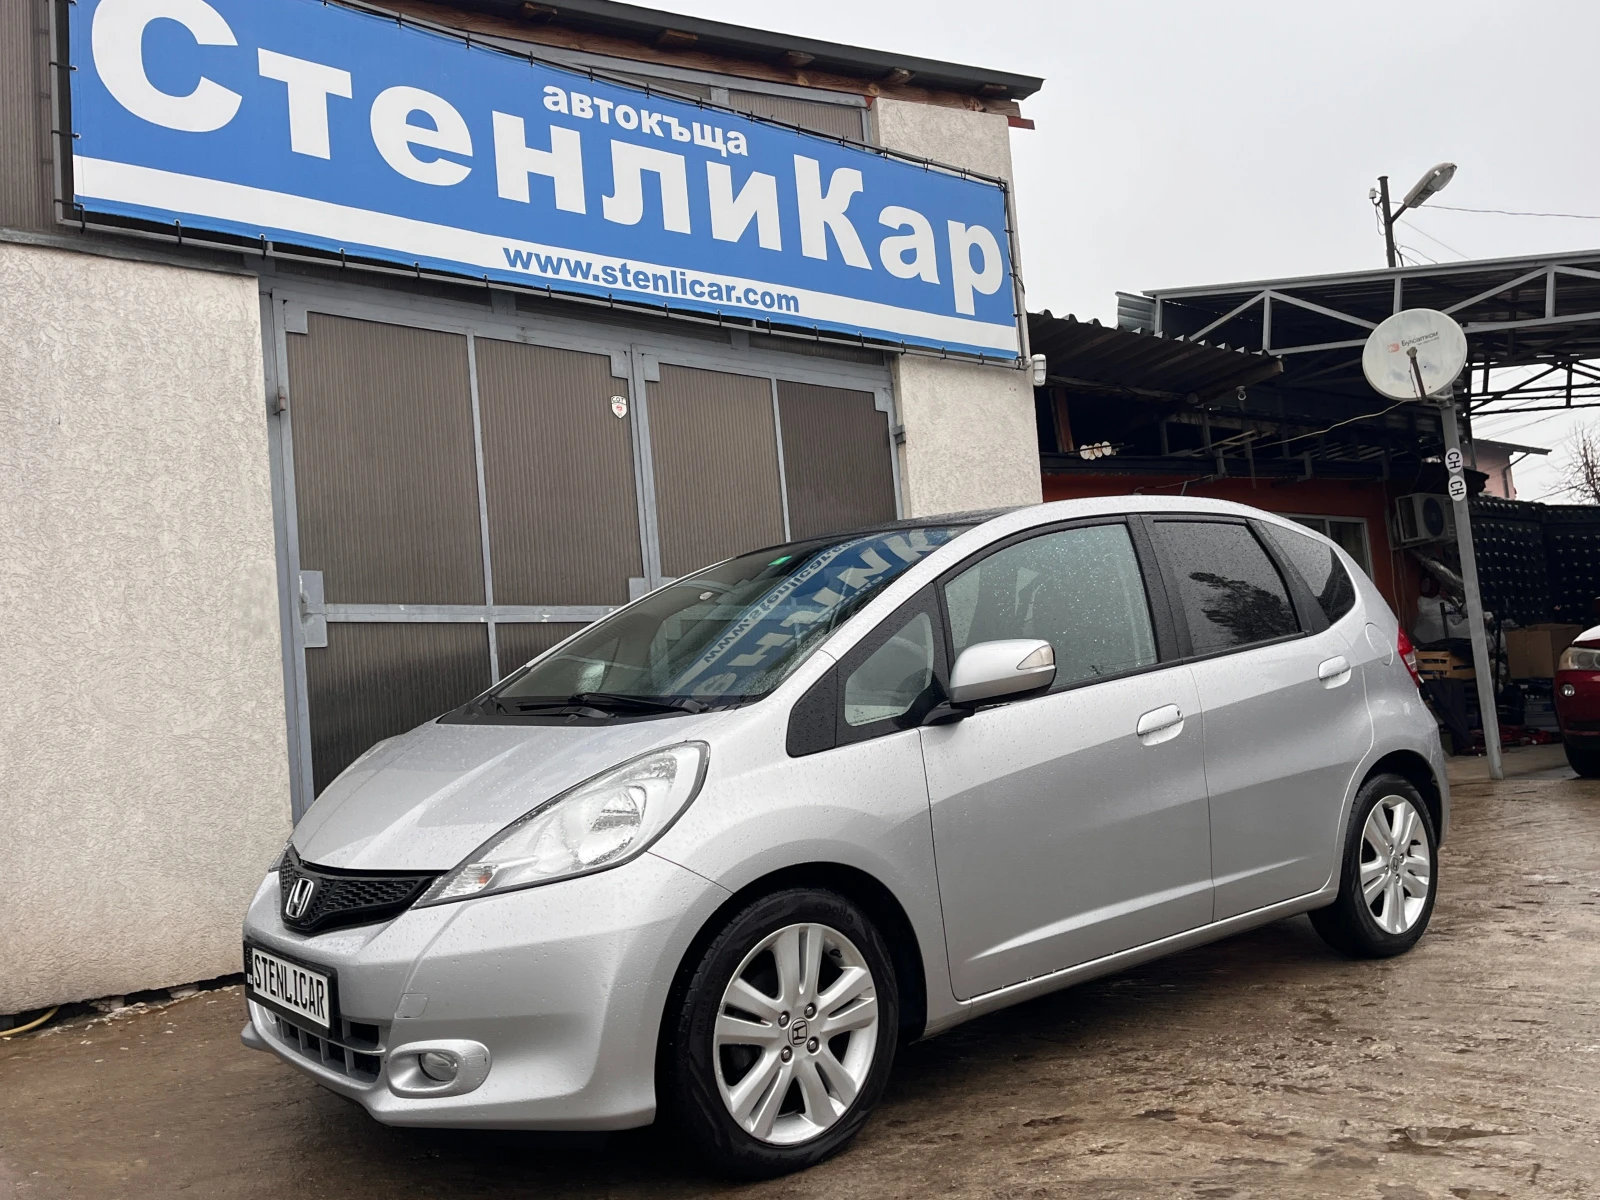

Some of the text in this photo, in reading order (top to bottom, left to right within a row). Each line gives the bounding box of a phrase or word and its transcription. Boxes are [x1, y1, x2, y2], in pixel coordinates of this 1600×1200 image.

[543, 85, 748, 157] автокъща
[91, 0, 1003, 316] СтенлиКар
[502, 247, 799, 314] www.stenlicar.com
[1447, 451, 1461, 470] CH
[1450, 481, 1465, 497] CH
[255, 954, 325, 1019] STENLICAR
